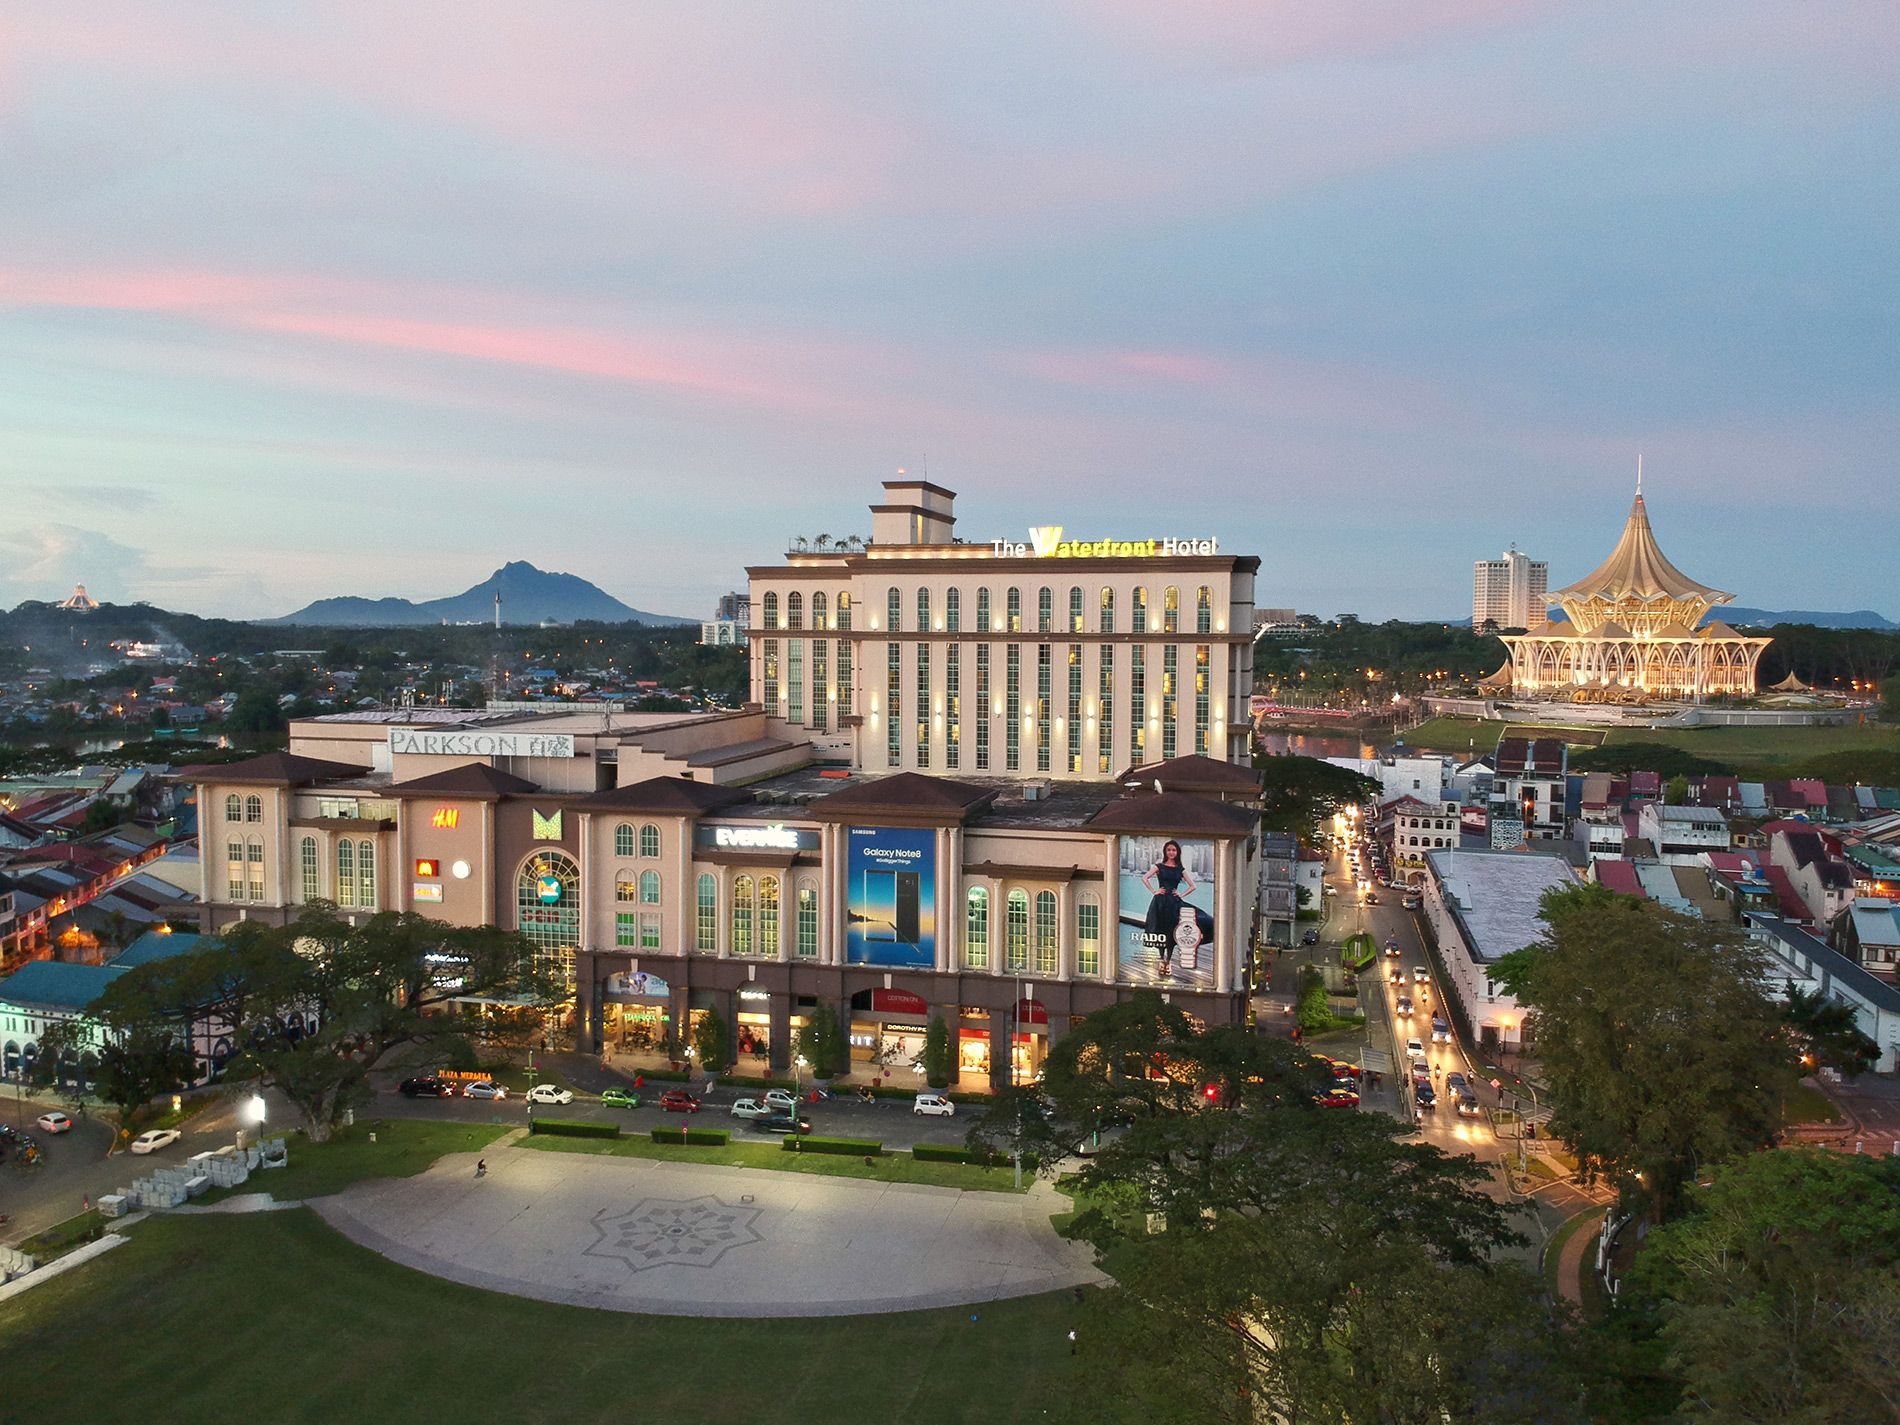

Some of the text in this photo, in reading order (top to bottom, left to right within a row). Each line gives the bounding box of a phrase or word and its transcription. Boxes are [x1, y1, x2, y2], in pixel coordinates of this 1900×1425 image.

[991, 526, 1217, 558] The Waterfront Hotel
[390, 731, 518, 757] PARKSON
[431, 808, 460, 829] H&M
[863, 847, 922, 859] Galaxy Note8
[1130, 932, 1167, 943] RADO
[887, 994, 909, 1002] COTTON
[887, 1024, 917, 1032] DOROTHY
[438, 1069, 458, 1079] PLAZA
